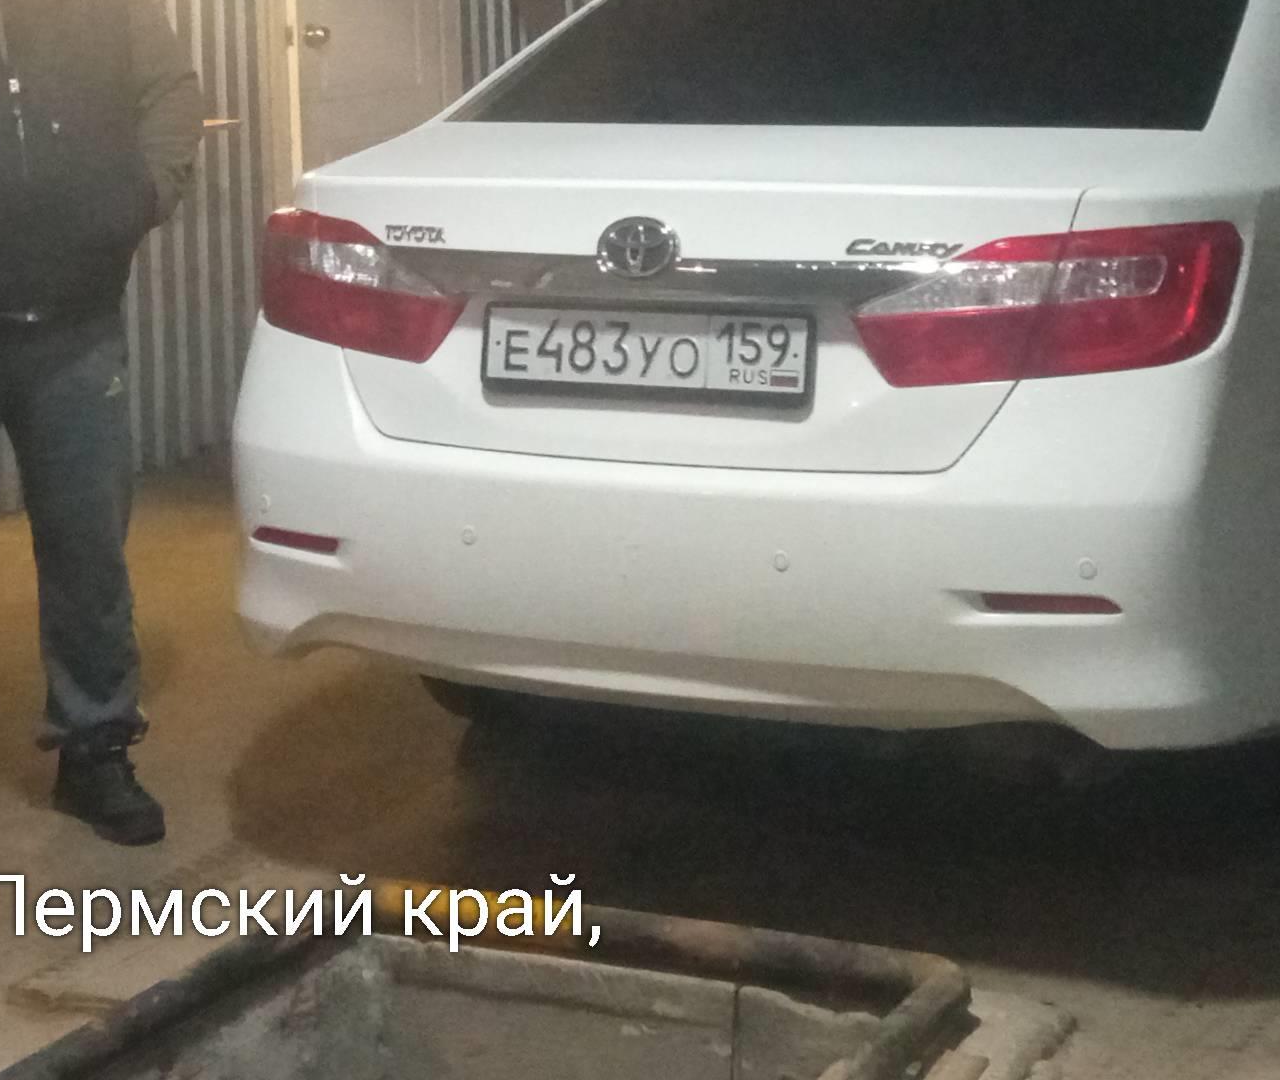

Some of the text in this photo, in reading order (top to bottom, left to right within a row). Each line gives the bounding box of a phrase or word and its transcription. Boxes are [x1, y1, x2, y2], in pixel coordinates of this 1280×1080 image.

[385, 224, 447, 245] TOYOTA
[716, 321, 792, 368] 159
[728, 368, 768, 385] RUS
